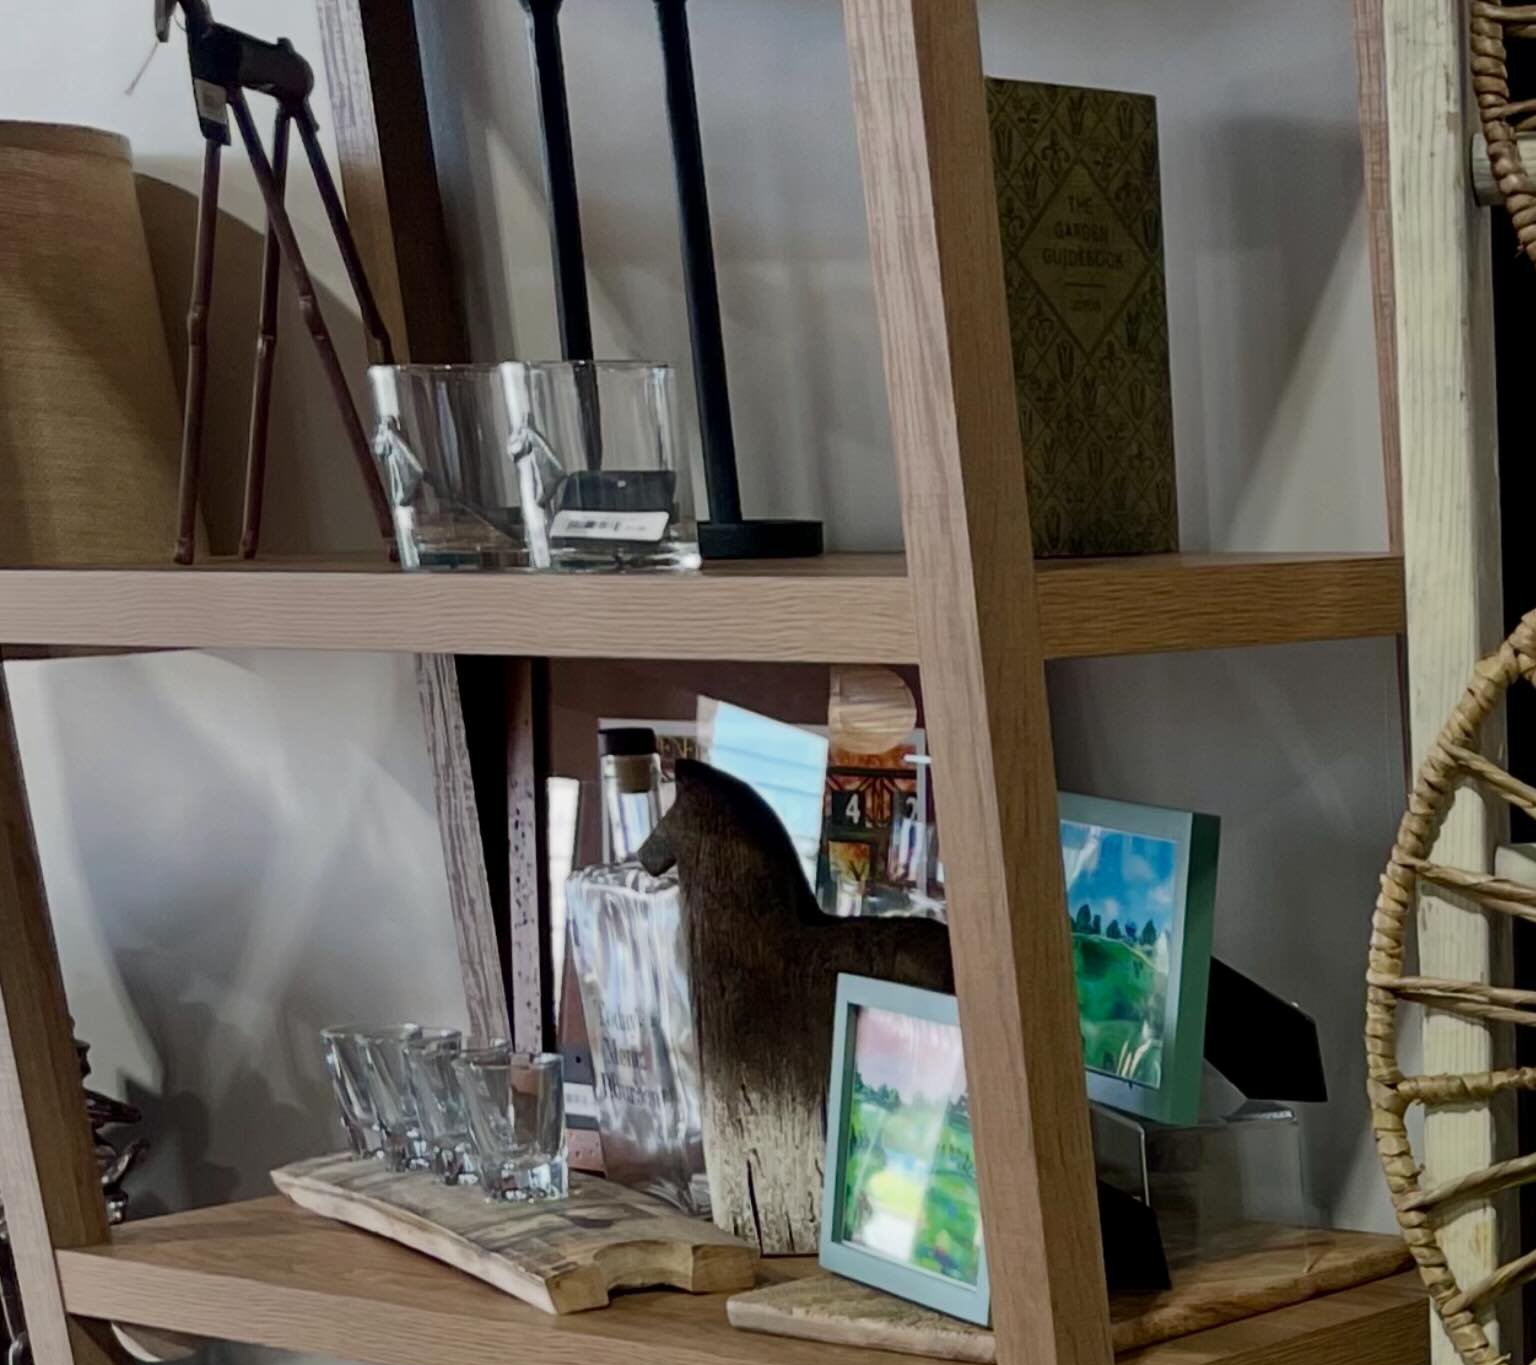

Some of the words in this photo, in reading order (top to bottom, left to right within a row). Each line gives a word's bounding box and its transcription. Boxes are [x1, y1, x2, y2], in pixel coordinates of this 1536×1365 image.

[1067, 194, 1094, 215] THE
[1055, 221, 1109, 243] GARDEN
[1042, 246, 1124, 269] GUIDEBOOK
